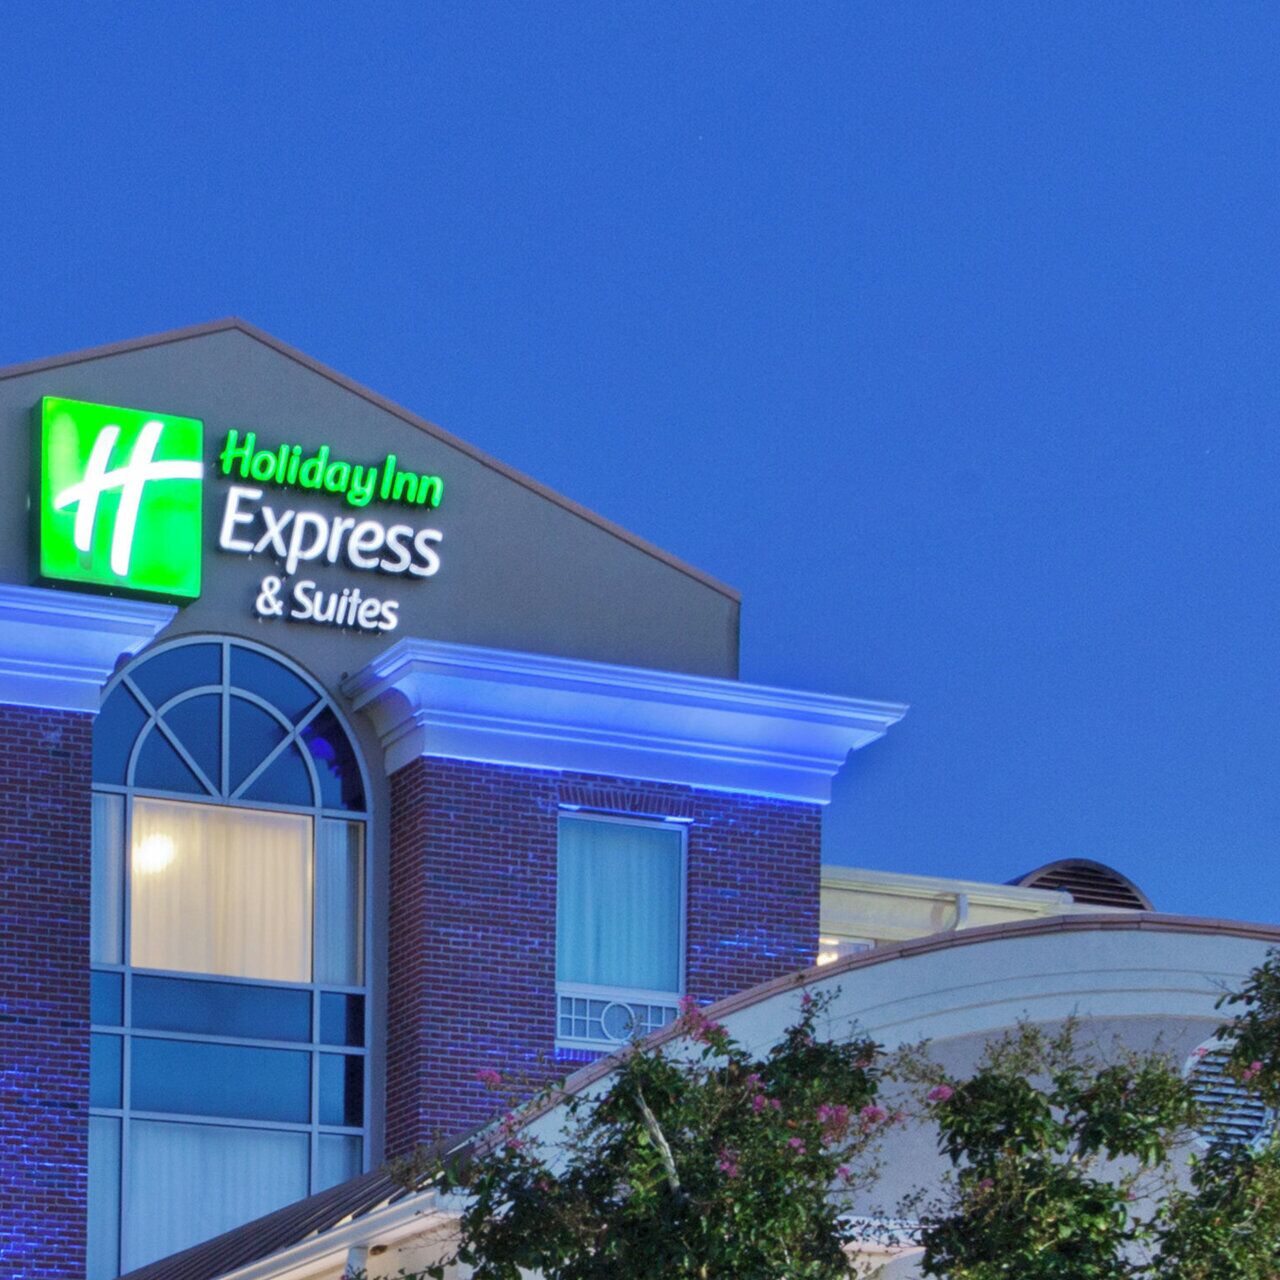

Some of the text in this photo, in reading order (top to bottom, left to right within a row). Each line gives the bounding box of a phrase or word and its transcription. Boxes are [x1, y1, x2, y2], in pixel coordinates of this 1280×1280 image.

[220, 429, 444, 508] Holiday Inn
[219, 485, 444, 577] Express
[256, 575, 400, 631] & Suites
